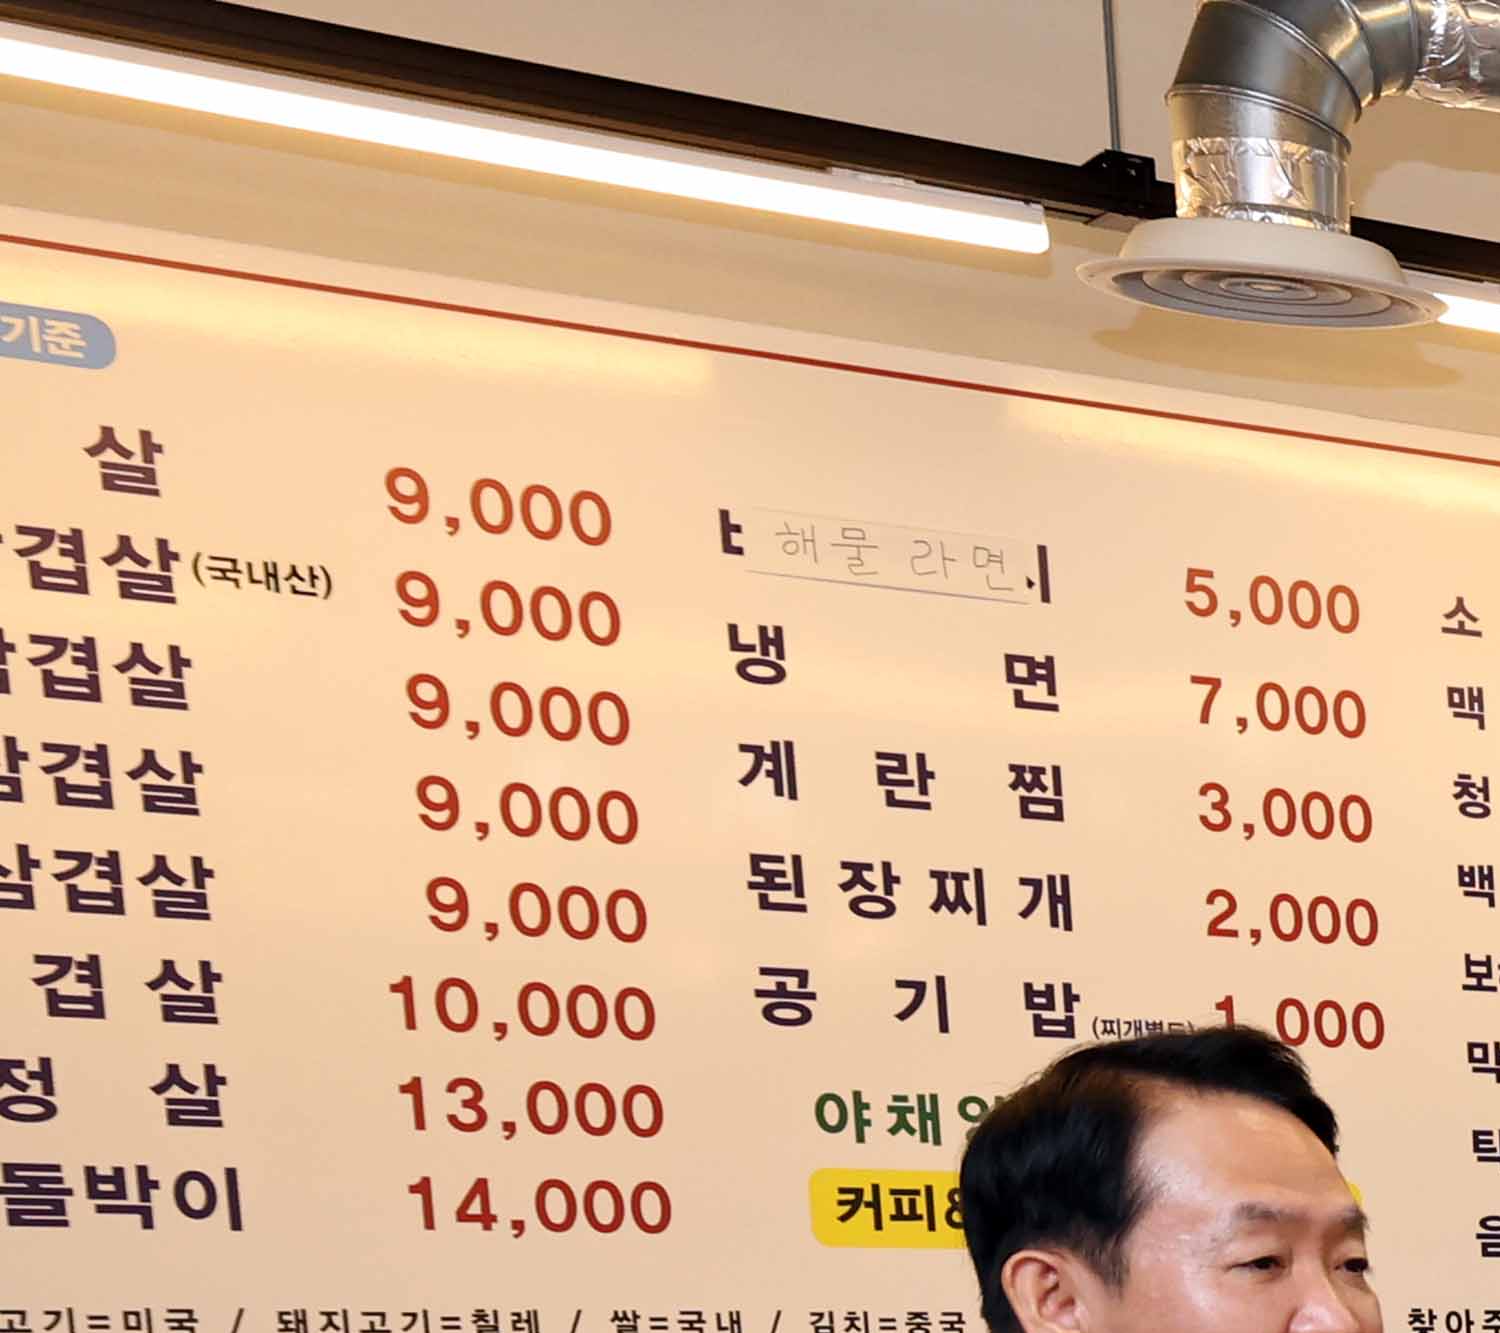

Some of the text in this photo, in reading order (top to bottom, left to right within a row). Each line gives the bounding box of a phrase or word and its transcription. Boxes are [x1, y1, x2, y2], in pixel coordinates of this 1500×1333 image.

[384, 466, 612, 547] 9,000
[192, 552, 333, 600] (국내산)
[395, 569, 622, 647] 9,000
[1184, 566, 1361, 635] 5,000
[405, 671, 632, 747] 9,000
[1189, 674, 1367, 739] 7,000
[415, 774, 641, 847] 9,000
[1198, 781, 1375, 844] 3,000
[425, 876, 650, 945] 9,000
[1206, 888, 1381, 948] 2,000
[390, 976, 657, 1042] 10,000
[400, 1076, 664, 1138] 13,000
[409, 1177, 672, 1235] 14,000
